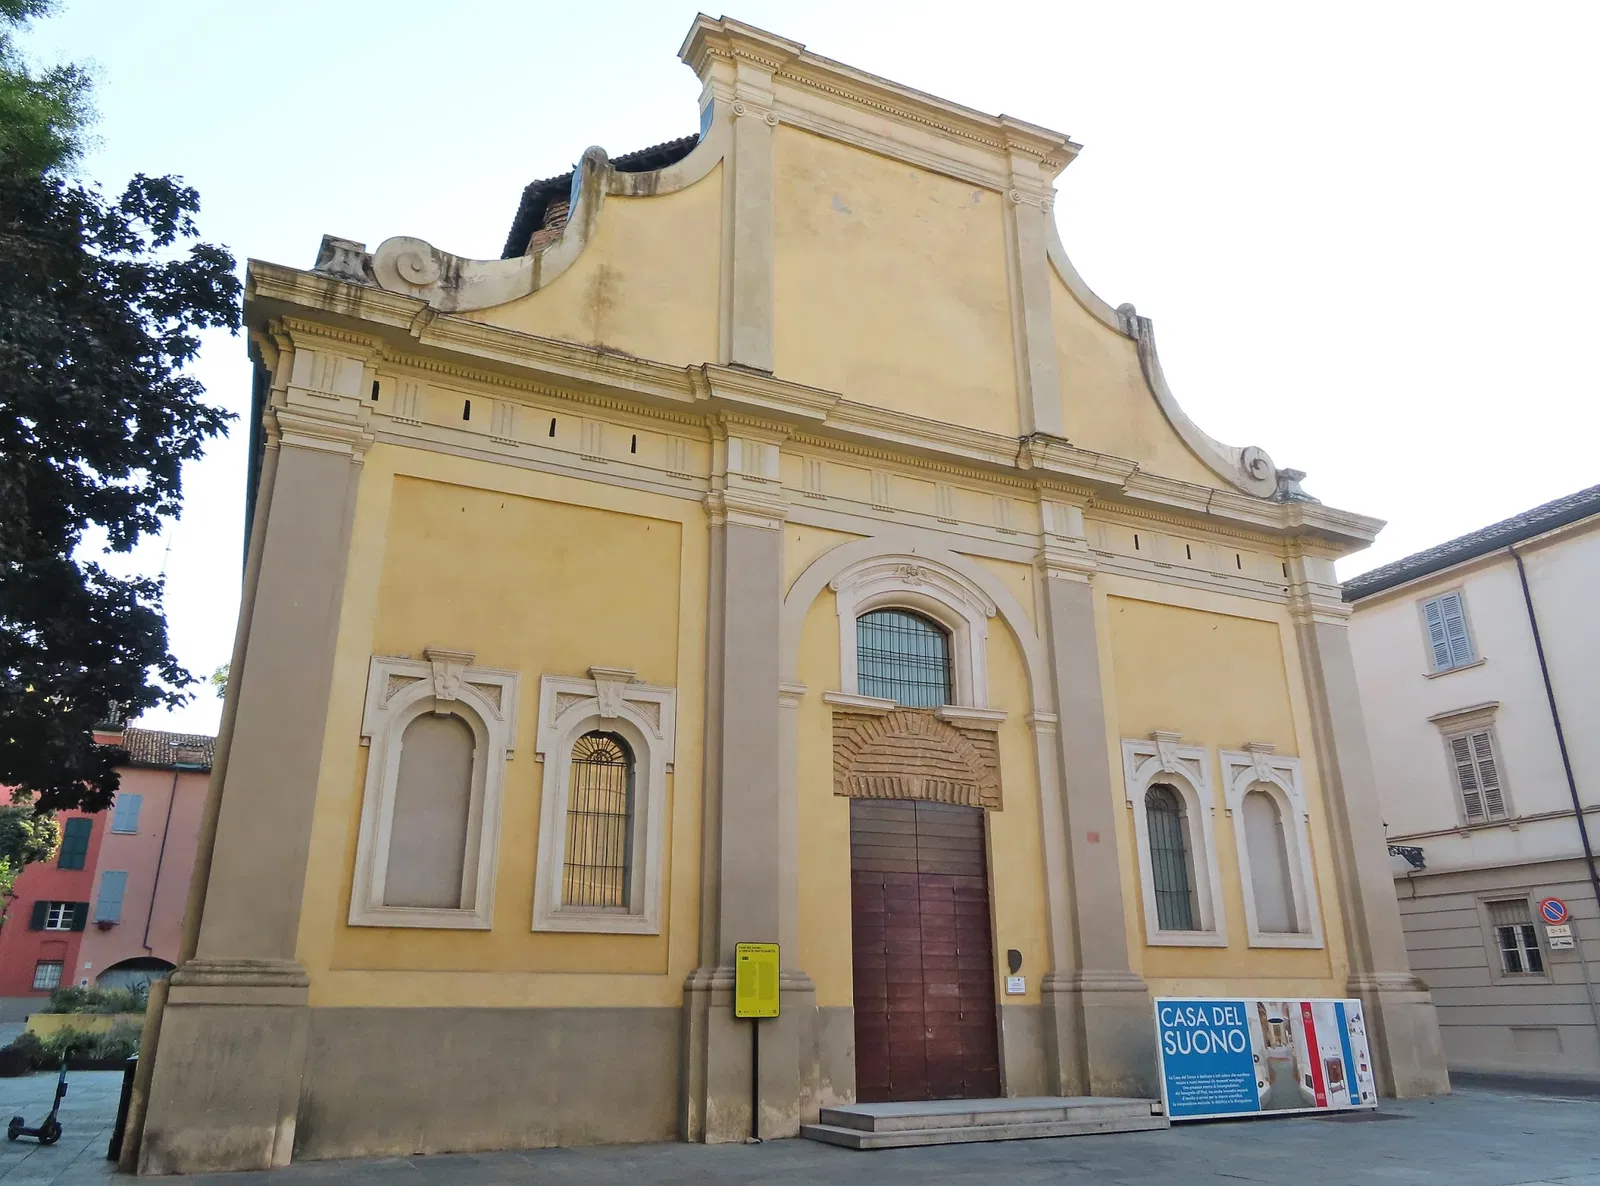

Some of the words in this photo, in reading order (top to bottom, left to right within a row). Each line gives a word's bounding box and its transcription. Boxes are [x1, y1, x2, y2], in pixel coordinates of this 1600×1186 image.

[1161, 1006, 1210, 1027] CASA
[1212, 1006, 1243, 1026] DEL
[1164, 1028, 1246, 1056] SUONO
